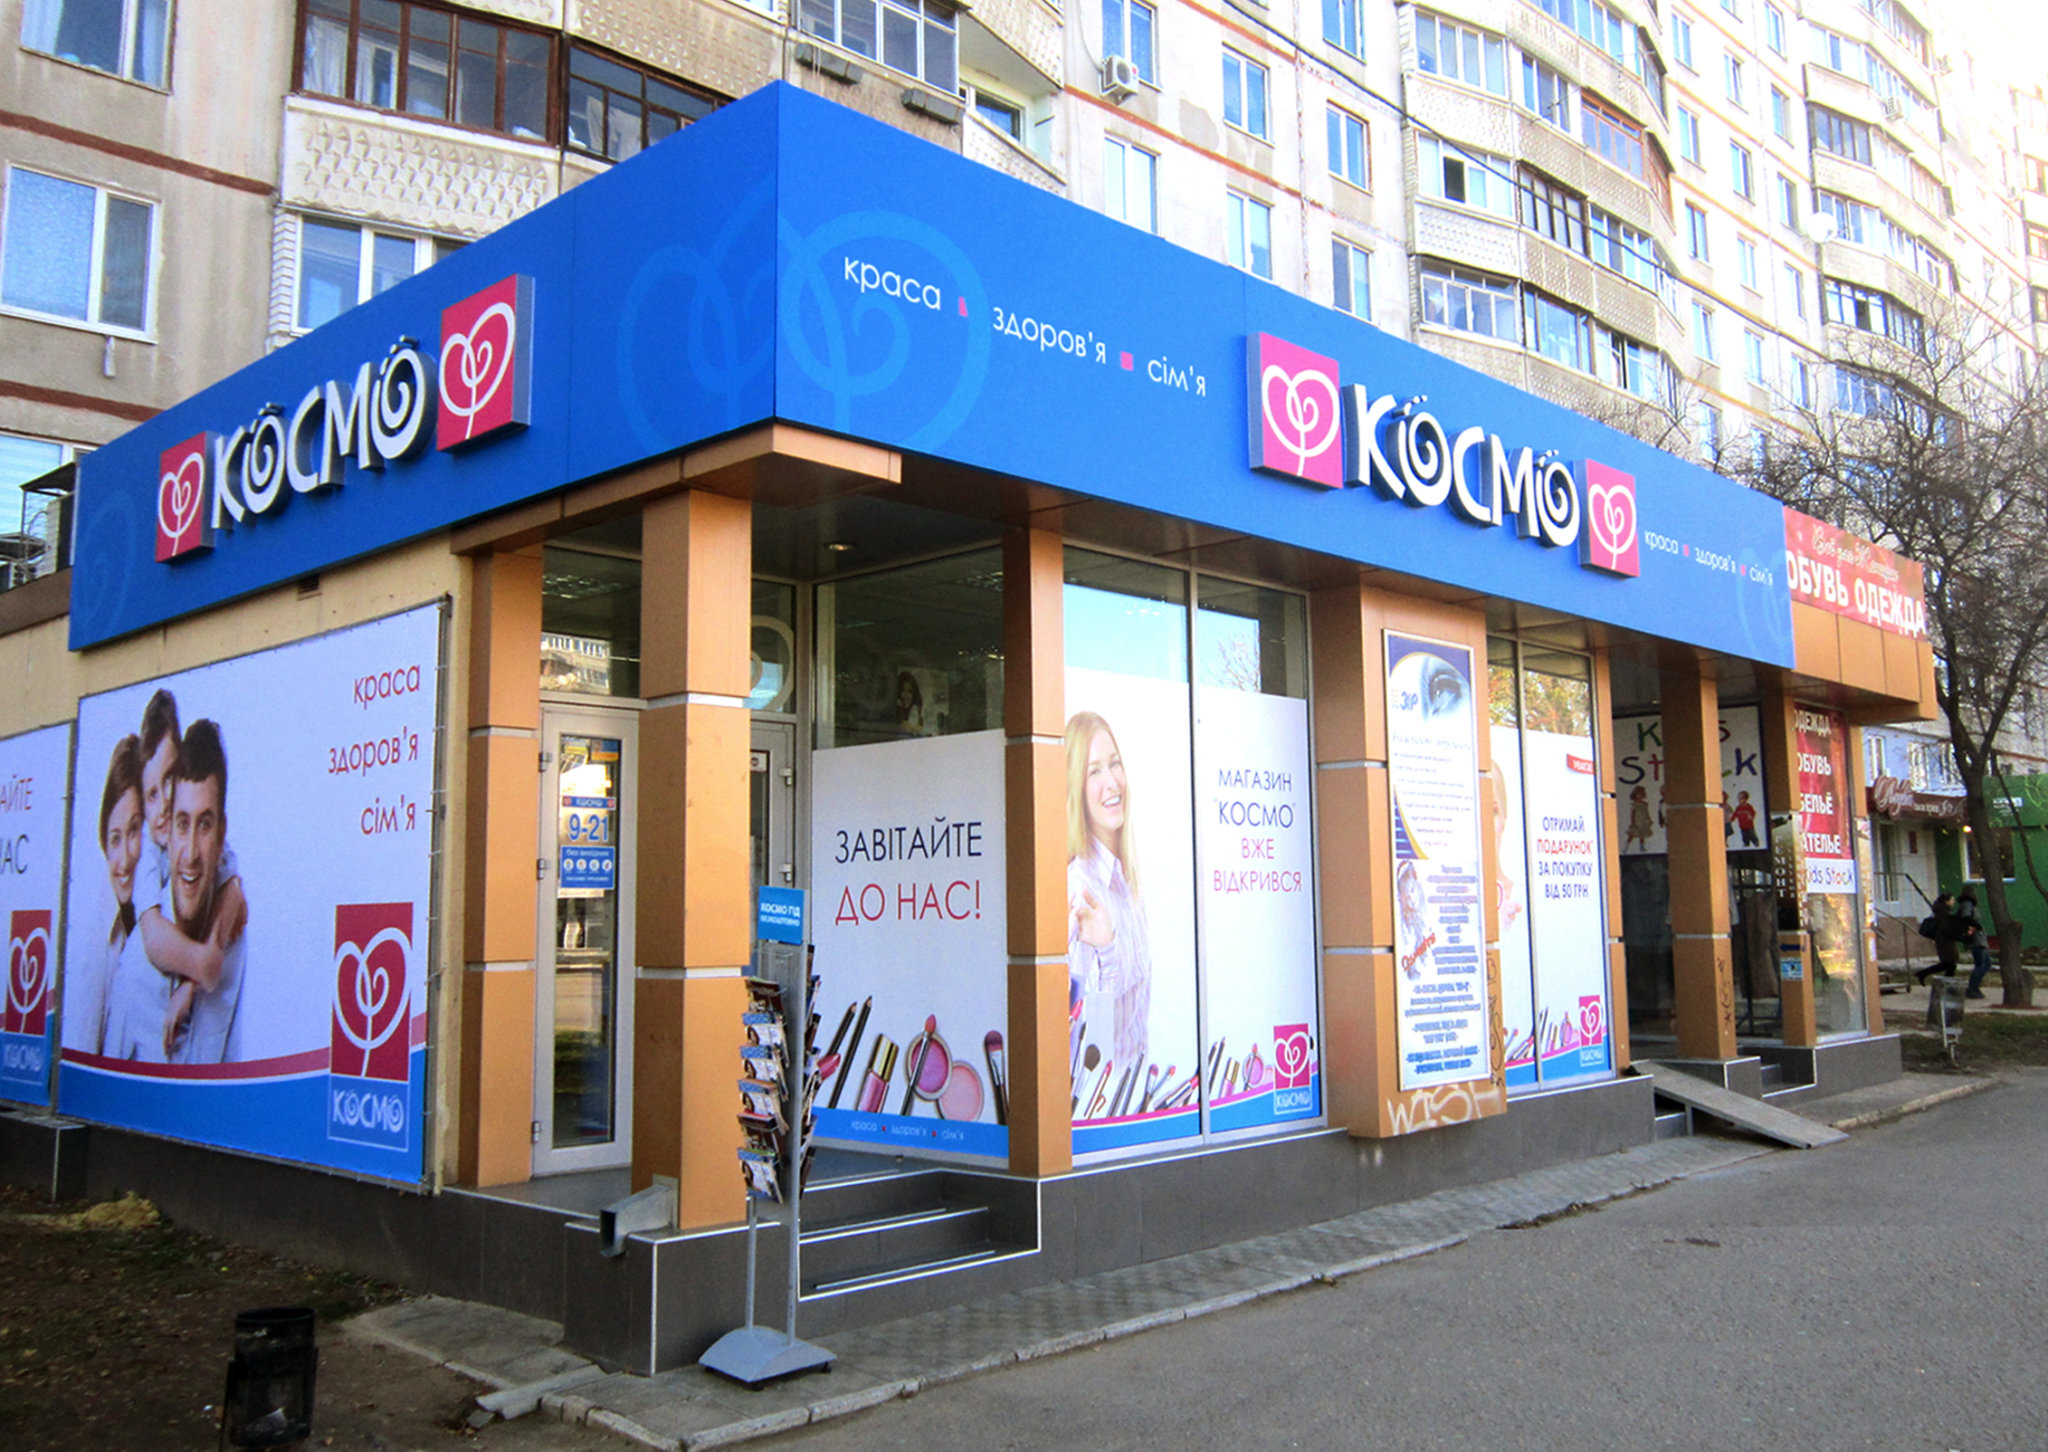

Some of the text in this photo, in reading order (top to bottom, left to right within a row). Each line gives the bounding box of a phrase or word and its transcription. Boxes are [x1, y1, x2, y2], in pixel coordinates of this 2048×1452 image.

[844, 256, 1207, 396] краса здоров'я сім'я
[210, 335, 426, 529] КОСМО
[1342, 384, 1580, 547] КОСМО
[1644, 530, 1773, 586] краса здоров'я сім'я
[1786, 549, 1926, 638] ОБУВЬ ОДЕЖДА
[353, 664, 421, 711] краса
[328, 725, 419, 777] здоров'я
[1218, 768, 1292, 792] МАГАЗИН
[360, 794, 416, 836] сім'я
[569, 812, 608, 842] 9-21
[1542, 815, 1585, 833] ОТРИМАЙ
[835, 816, 982, 864] ЗАВІТАЙТЕ
[1241, 837, 1274, 860] ВЖЕ
[1213, 869, 1302, 894] ВІДКРИВСЯ
[1538, 861, 1593, 876] ЗА ПОКУПКУ
[835, 879, 981, 926] ДО НАС!
[1544, 884, 1589, 900] ВІД 50 ГРН
[332, 1089, 404, 1133] КОСМО
